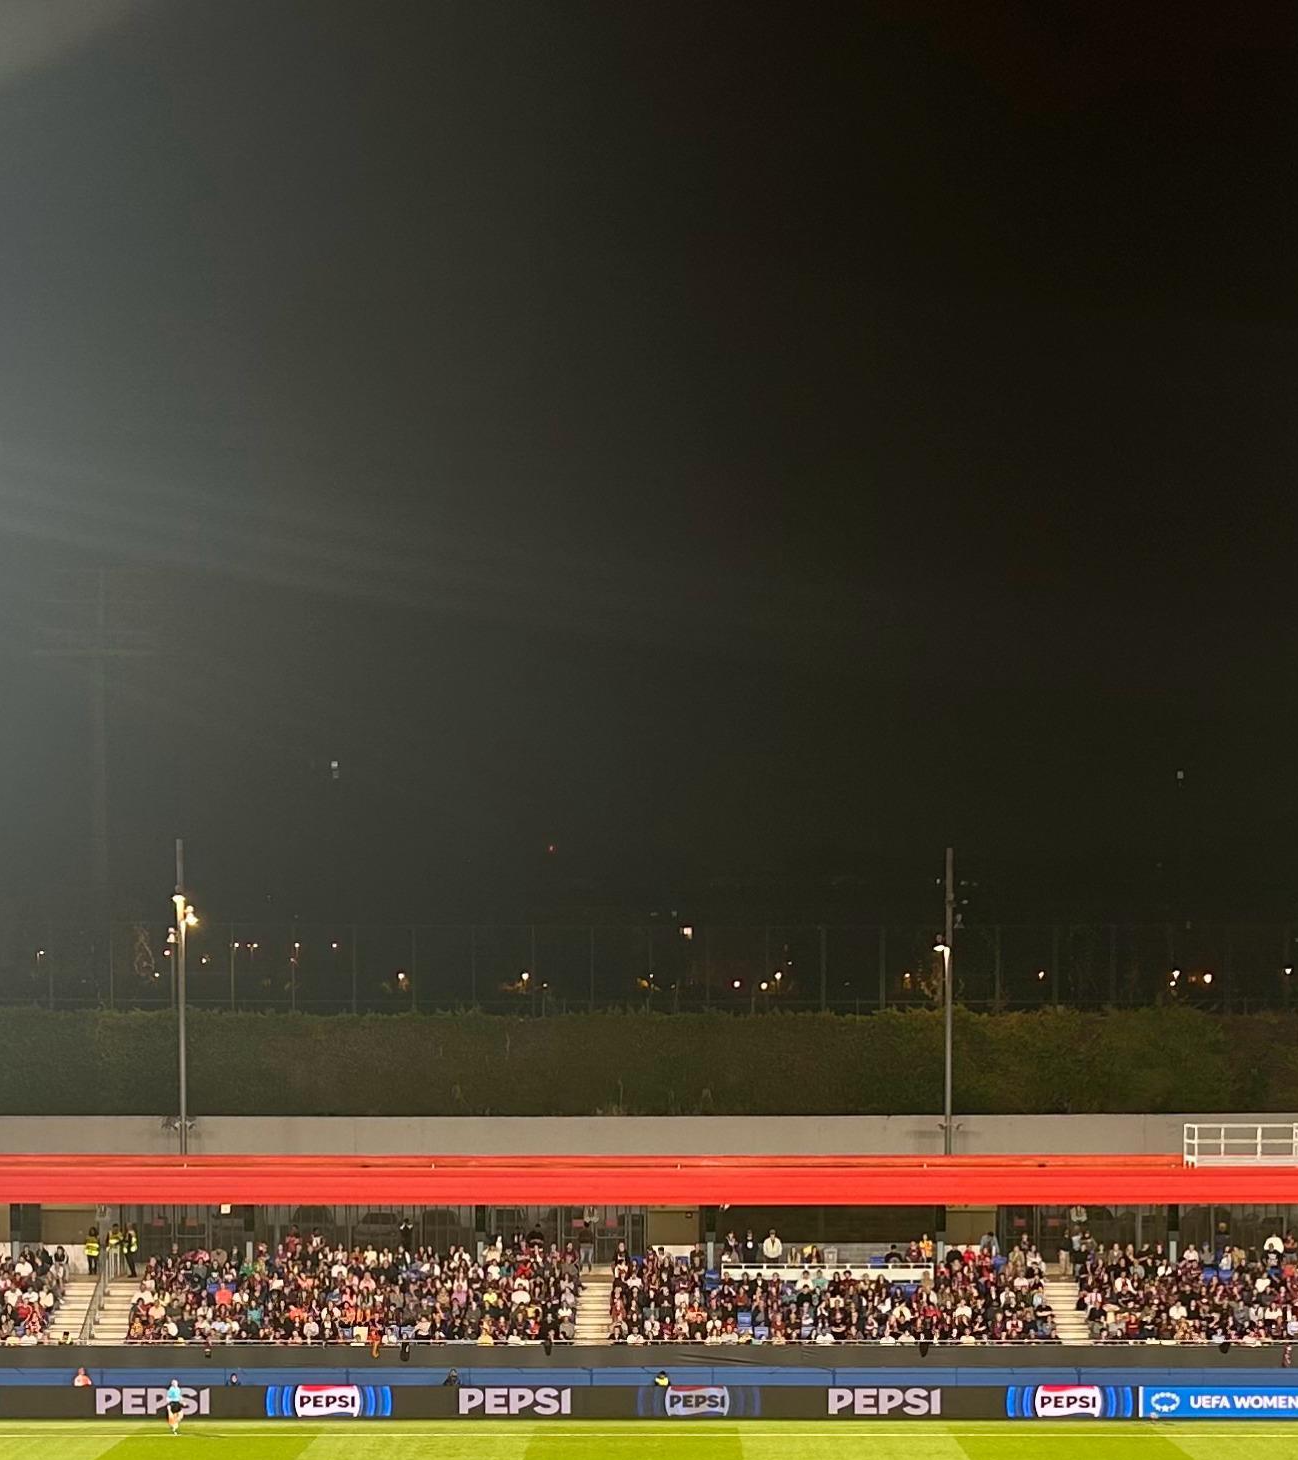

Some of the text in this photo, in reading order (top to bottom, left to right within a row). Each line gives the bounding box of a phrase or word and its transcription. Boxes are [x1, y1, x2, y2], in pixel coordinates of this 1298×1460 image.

[96, 1388, 210, 1415] PEPSI
[300, 1395, 356, 1409] PEPSI
[459, 1388, 572, 1416] PEPSI
[669, 1395, 726, 1410] PEPSI
[828, 1388, 941, 1416] PEPSI
[1040, 1395, 1097, 1409] PEPSI
[1190, 1395, 1230, 1409] UEFA
